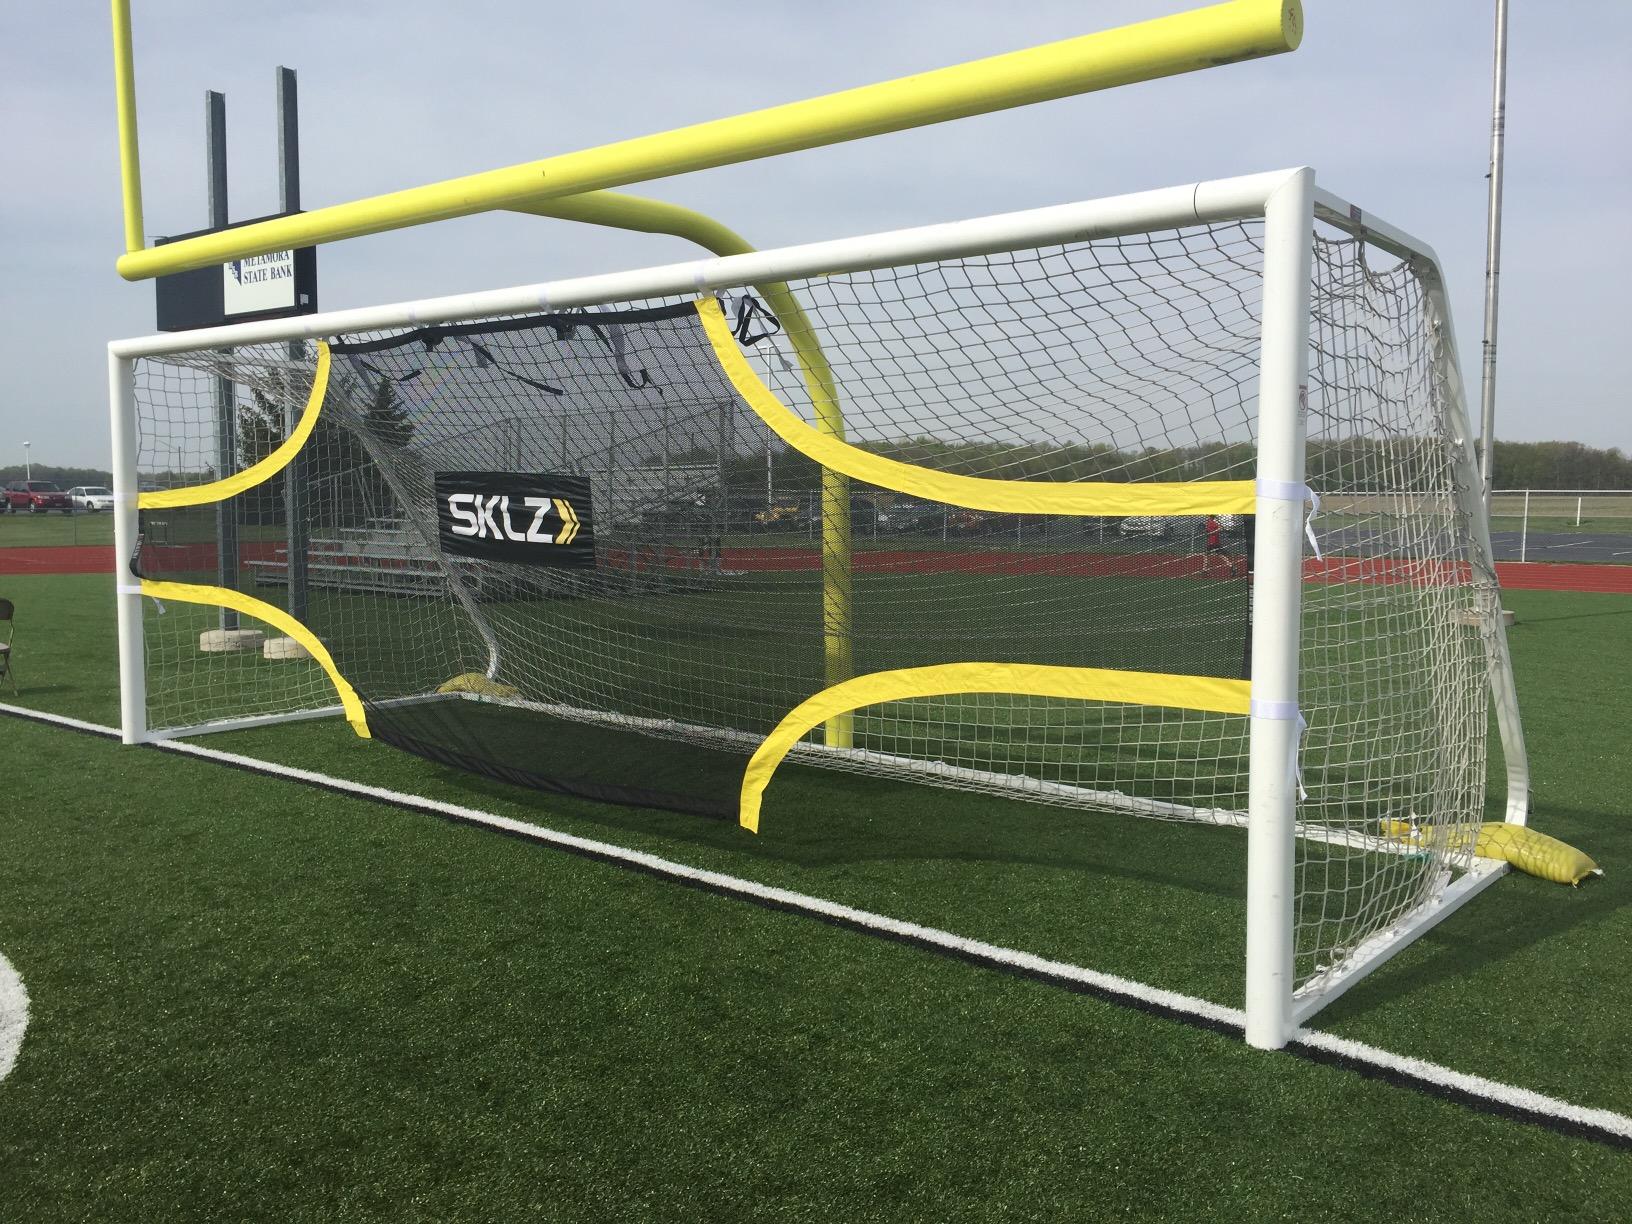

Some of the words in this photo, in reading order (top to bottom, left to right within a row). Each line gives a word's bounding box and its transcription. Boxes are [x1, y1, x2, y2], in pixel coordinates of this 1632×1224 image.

[243, 268, 268, 284] STATE
[270, 264, 293, 280] BANK
[448, 493, 553, 543] SKLZ
